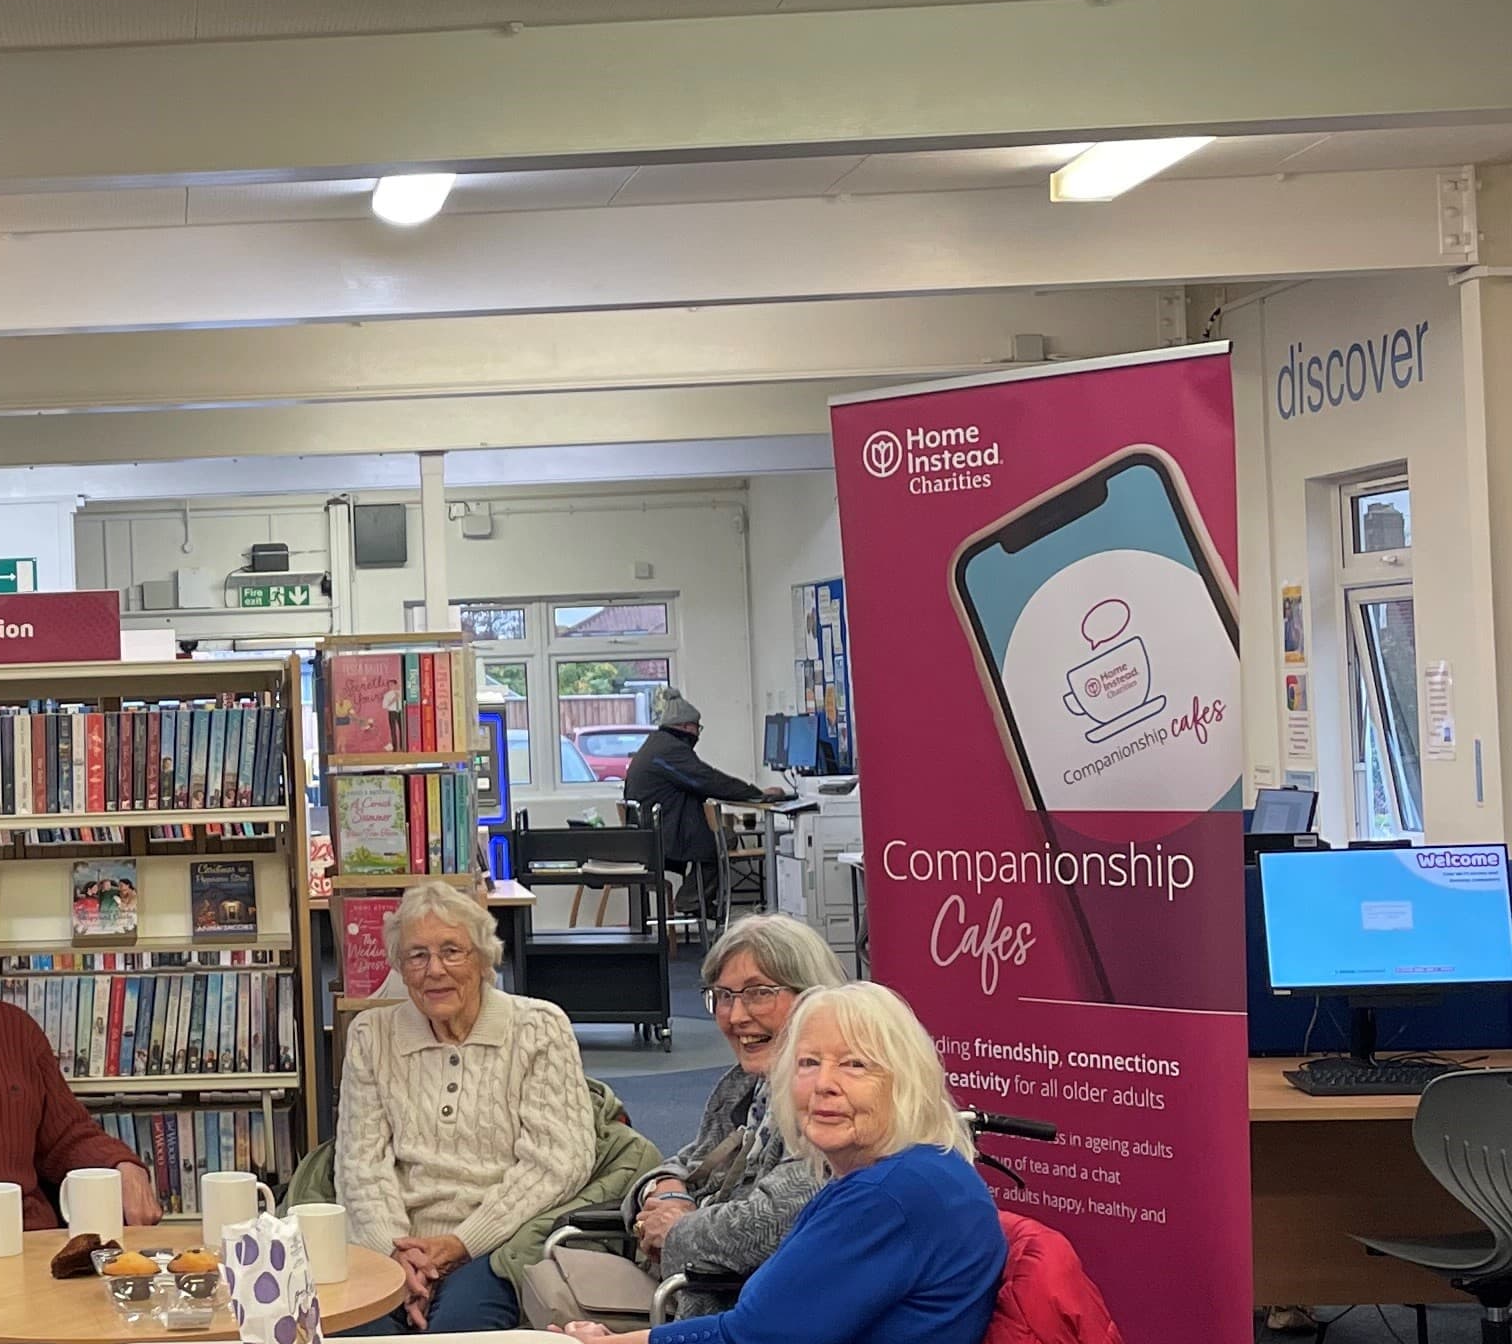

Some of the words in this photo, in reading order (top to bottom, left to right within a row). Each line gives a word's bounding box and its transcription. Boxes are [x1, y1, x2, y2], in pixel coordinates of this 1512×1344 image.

[1277, 320, 1429, 420] discover
[906, 425, 980, 450] Home
[909, 470, 992, 495] Charities
[244, 587, 263, 597] Fire
[244, 597, 263, 606] exit
[1100, 663, 1128, 682] Home
[1103, 667, 1138, 691] Instead
[1106, 680, 1138, 699] Charities
[1063, 727, 1168, 785] Companionship
[1171, 696, 1227, 745] cafes
[883, 840, 1195, 901] Companionship
[1416, 851, 1500, 868] Welcome
[348, 943, 385, 958] Weddin
[930, 894, 1036, 995] Cafes
[974, 1038, 1063, 1070] friendship,
[1068, 1051, 1180, 1077] connections
[944, 1070, 1011, 1097] reativity
[1014, 1074, 1037, 1094] for
[1040, 1078, 1058, 1098] all
[1062, 1083, 1108, 1103] older
[1112, 1087, 1165, 1110] adults
[1069, 1132, 1082, 1147] in
[1084, 1136, 1130, 1157] ageing
[1132, 1141, 1174, 1159] adults
[1014, 1156, 1028, 1171] of
[1030, 1159, 1050, 1175] tea
[1052, 1163, 1077, 1179] and
[1080, 1167, 1088, 1180] a
[1091, 1166, 1121, 1185] chat
[1003, 1186, 1039, 1205] adults
[1042, 1191, 1085, 1214] happy,
[1088, 1197, 1138, 1223] healthy
[1140, 1208, 1166, 1224] and
